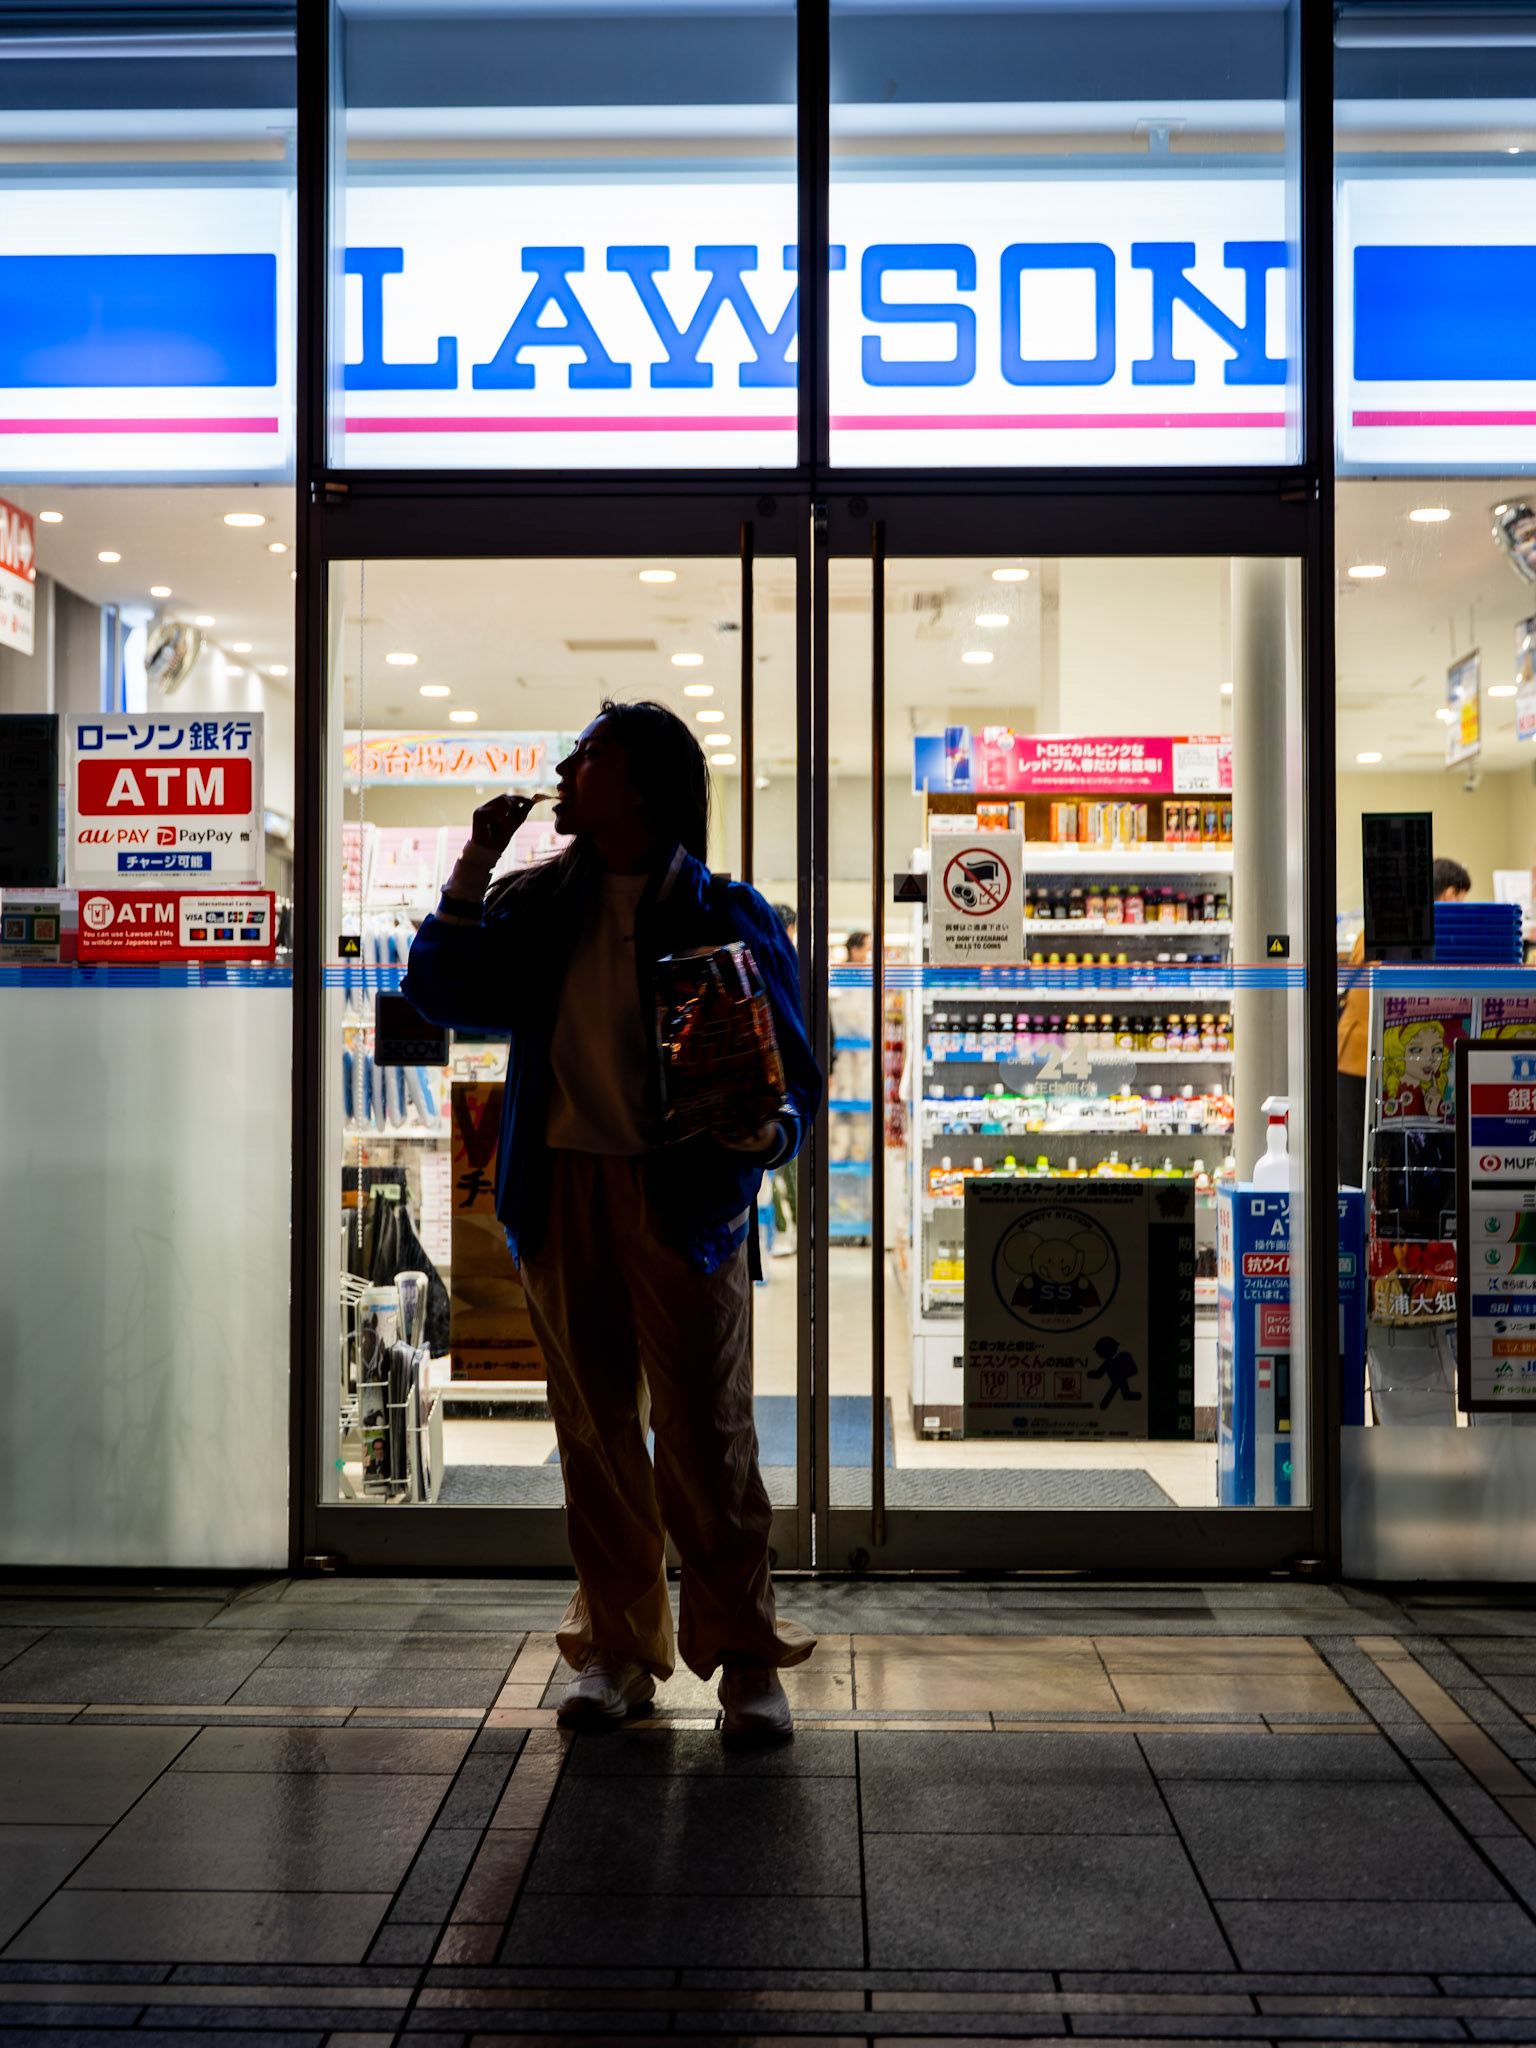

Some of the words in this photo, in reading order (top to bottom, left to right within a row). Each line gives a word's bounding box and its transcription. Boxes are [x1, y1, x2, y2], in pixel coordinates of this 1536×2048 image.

[344, 241, 1288, 391] LAWSON
[77, 721, 252, 751] ローソン銀行
[350, 744, 544, 774] お台場みやげ
[106, 767, 225, 807] ATM
[78, 829, 115, 844] au
[116, 829, 150, 844] PAY
[179, 829, 233, 844] PayPay
[126, 855, 203, 869] チャージ可能
[116, 903, 175, 924] ATM
[185, 913, 203, 921] VISA
[83, 930, 95, 938] You
[125, 930, 153, 938] Lawson
[154, 930, 174, 938] ATMs
[91, 938, 123, 946] withdraw
[125, 938, 158, 947] Japanese
[1035, 1040, 1093, 1080] 24
[1033, 1081, 1098, 1097] 年中無休
[1504, 1158, 1536, 1170] MUF
[1018, 1212, 1052, 1231] SAFETY
[1055, 1212, 1094, 1231] STATION
[1490, 1303, 1510, 1314] SBI
[983, 1373, 1005, 1385] 110
[1019, 1373, 1042, 1385] 119
